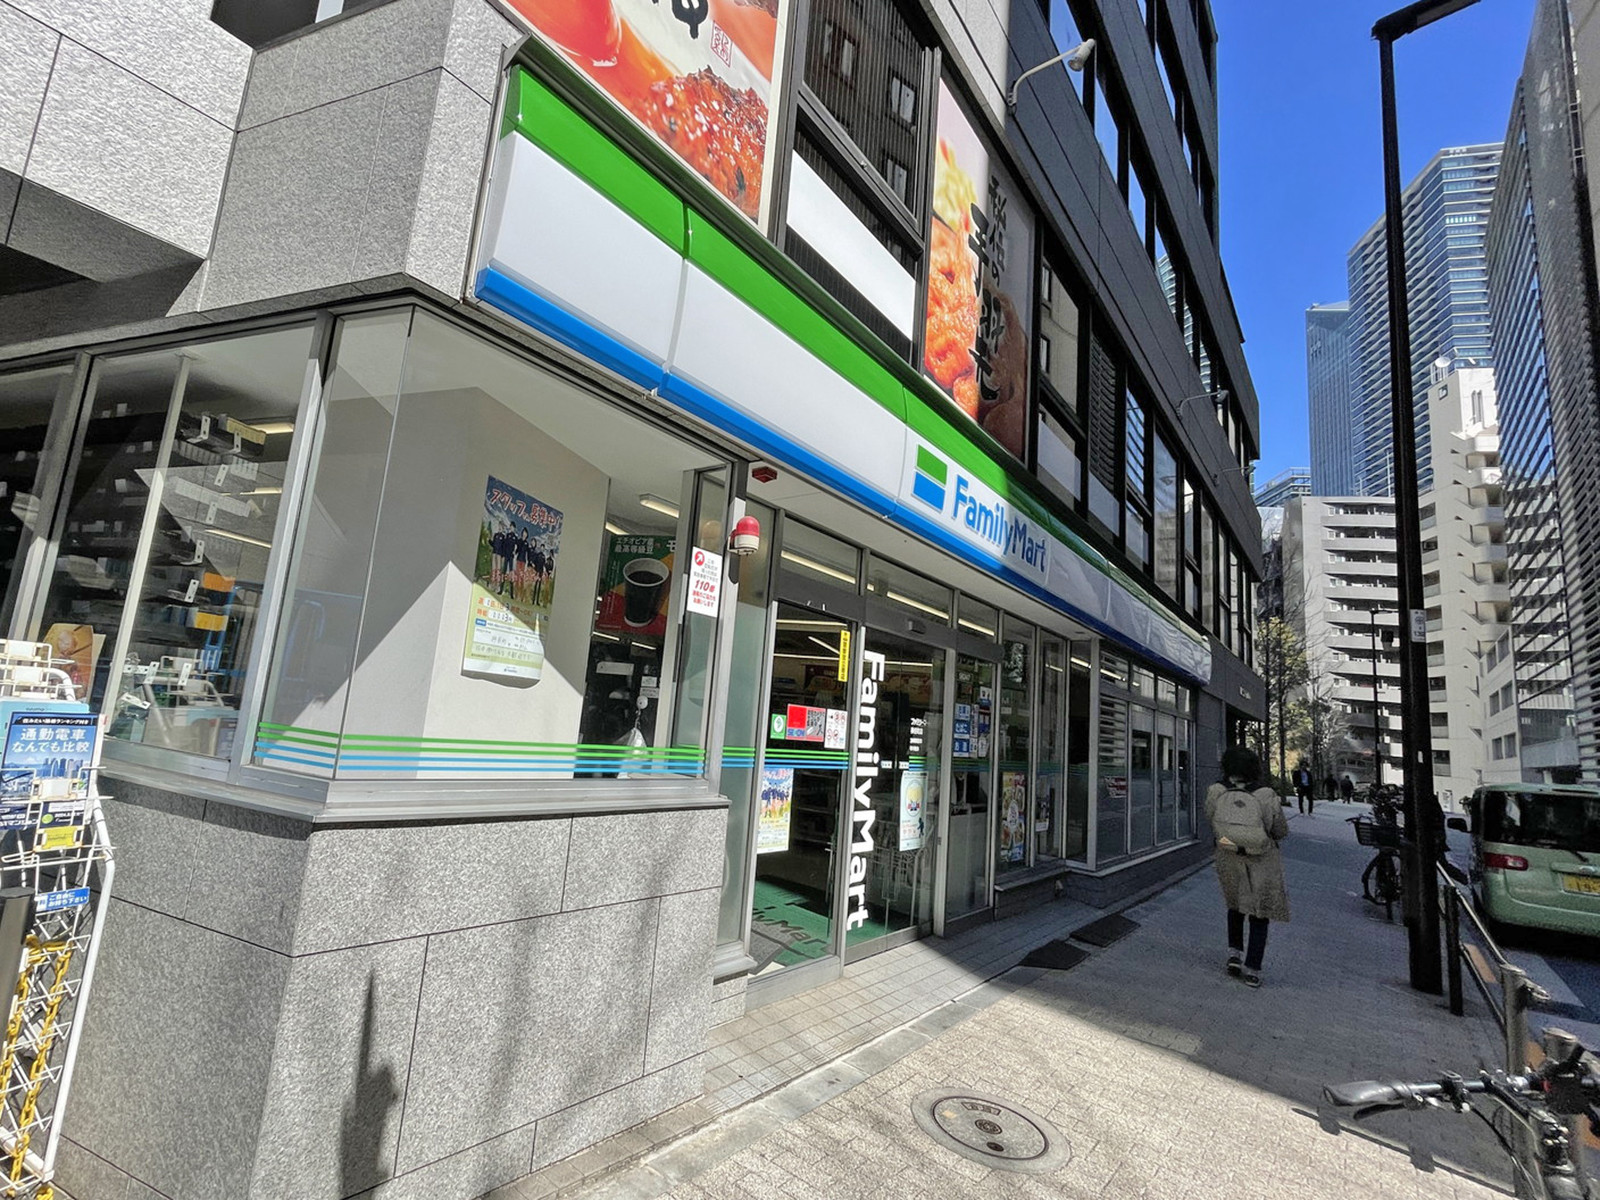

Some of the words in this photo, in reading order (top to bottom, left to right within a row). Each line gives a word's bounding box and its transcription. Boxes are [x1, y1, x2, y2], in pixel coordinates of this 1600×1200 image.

[952, 474, 1046, 573] FamilyMart
[12, 741, 90, 753] なんでも比較
[21, 728, 86, 741] 通勤電車
[847, 650, 885, 931] FamilyMart
